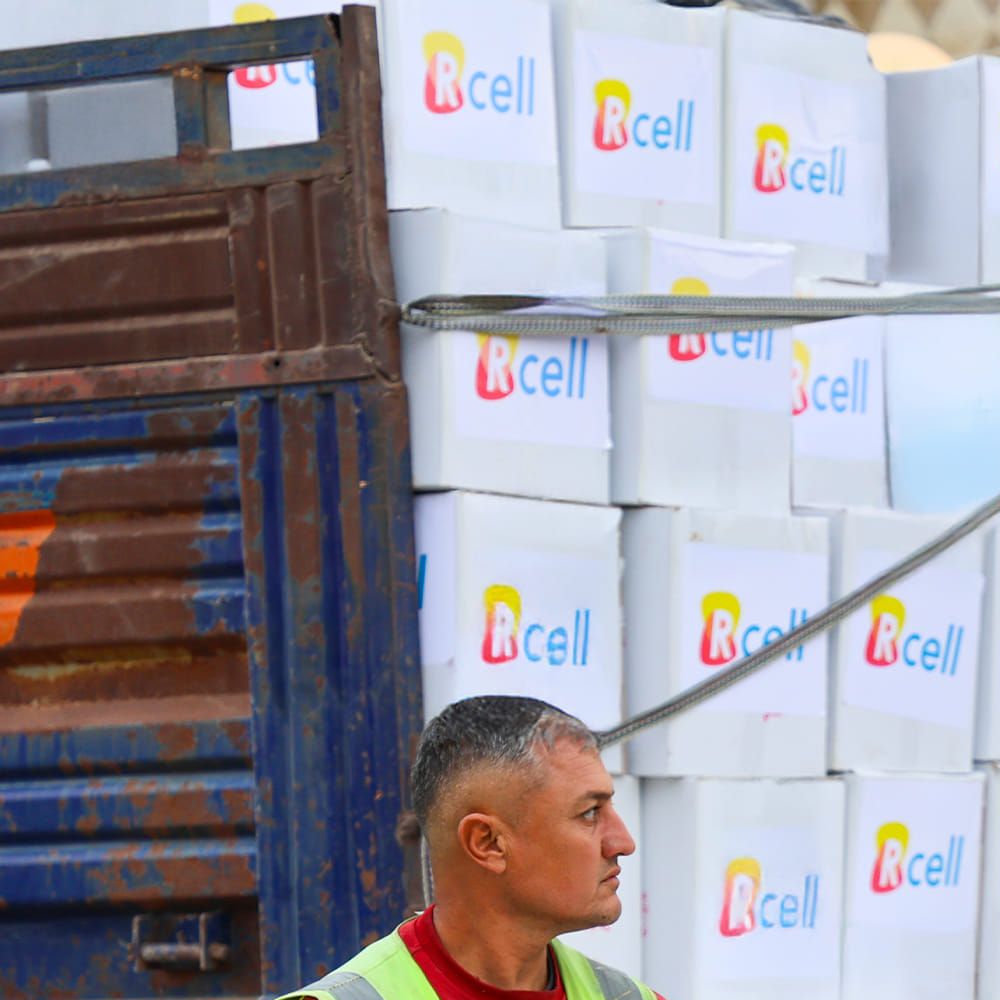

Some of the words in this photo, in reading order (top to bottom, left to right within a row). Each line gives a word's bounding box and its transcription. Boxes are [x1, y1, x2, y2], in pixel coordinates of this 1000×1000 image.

[430, 52, 536, 117] Rcell
[600, 97, 696, 153] Rcell
[759, 140, 847, 198] Rcell
[482, 336, 590, 401] Rcell
[676, 328, 774, 360] cell
[488, 603, 592, 668] Rcell
[871, 612, 966, 678] Rcell
[877, 835, 966, 889] Rcell
[725, 875, 822, 931] Rcell
